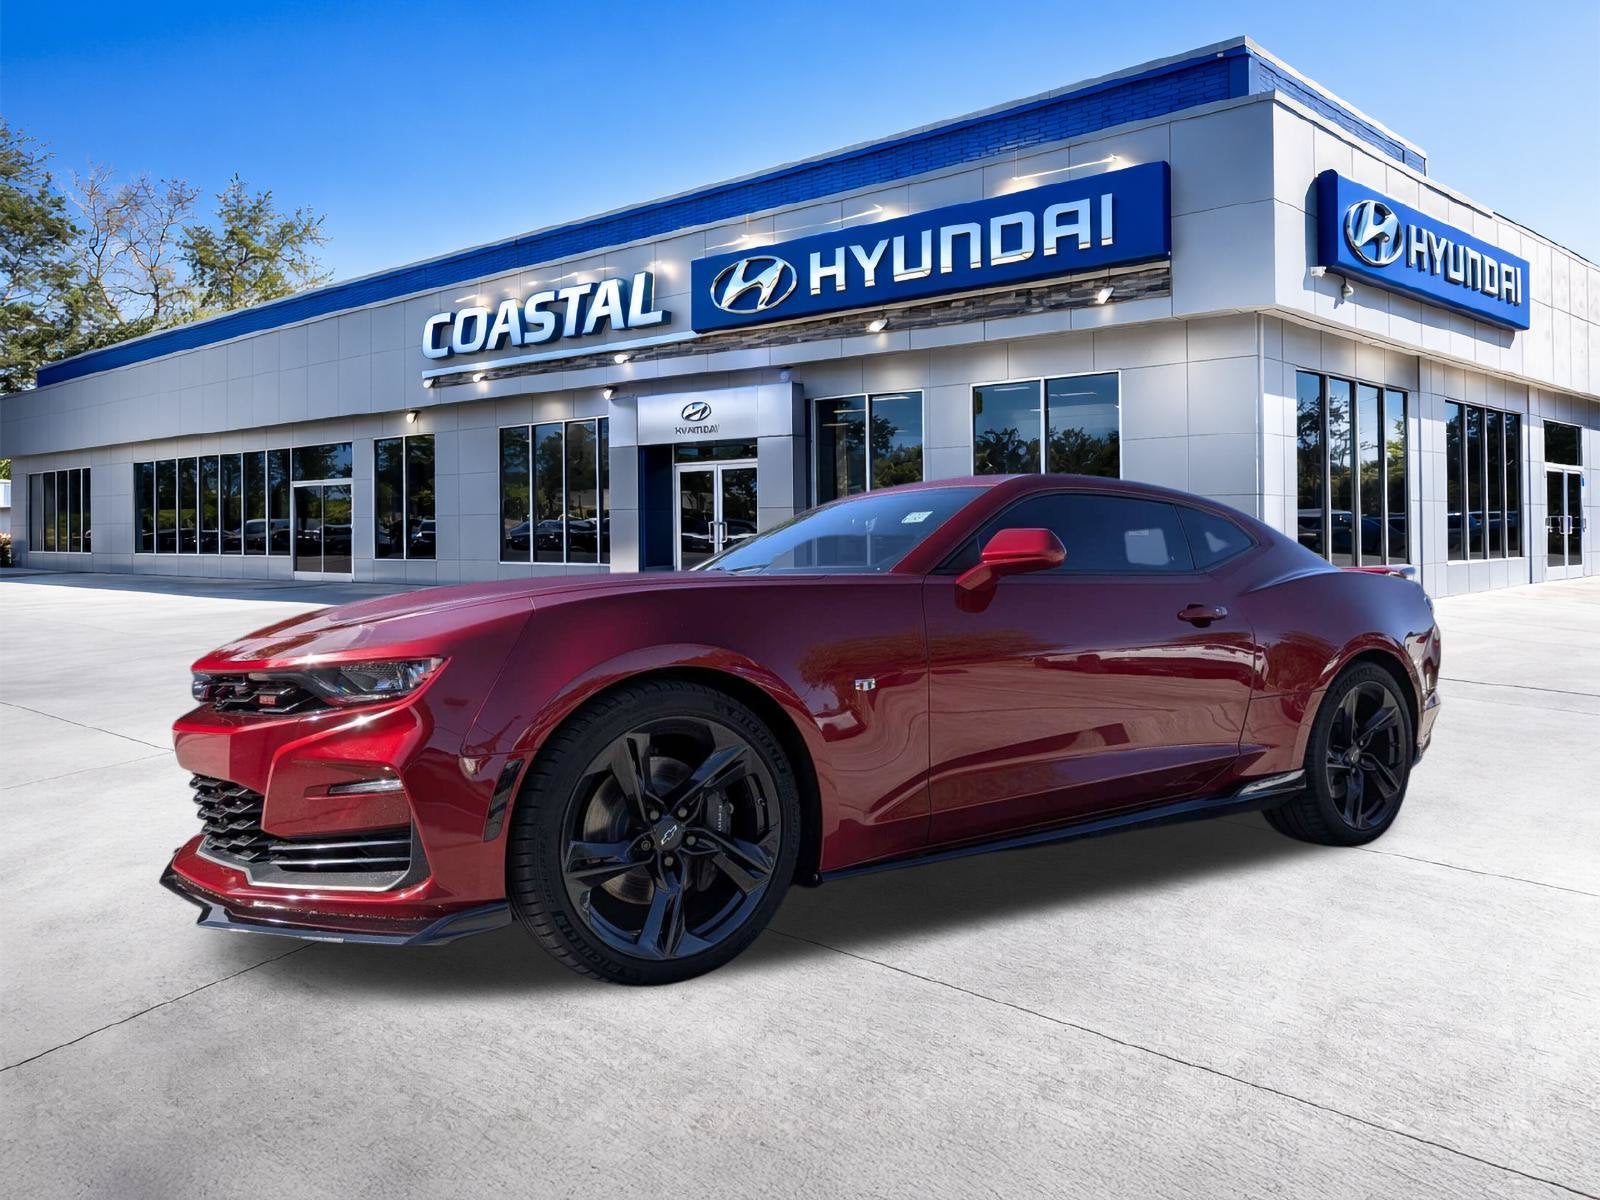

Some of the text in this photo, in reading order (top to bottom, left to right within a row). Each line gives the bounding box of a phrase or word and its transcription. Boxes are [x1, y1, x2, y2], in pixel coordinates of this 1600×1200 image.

[809, 192, 1113, 296] HYUNDAI
[1406, 223, 1522, 306] HYUNDAI
[421, 271, 666, 360] COASTAL
